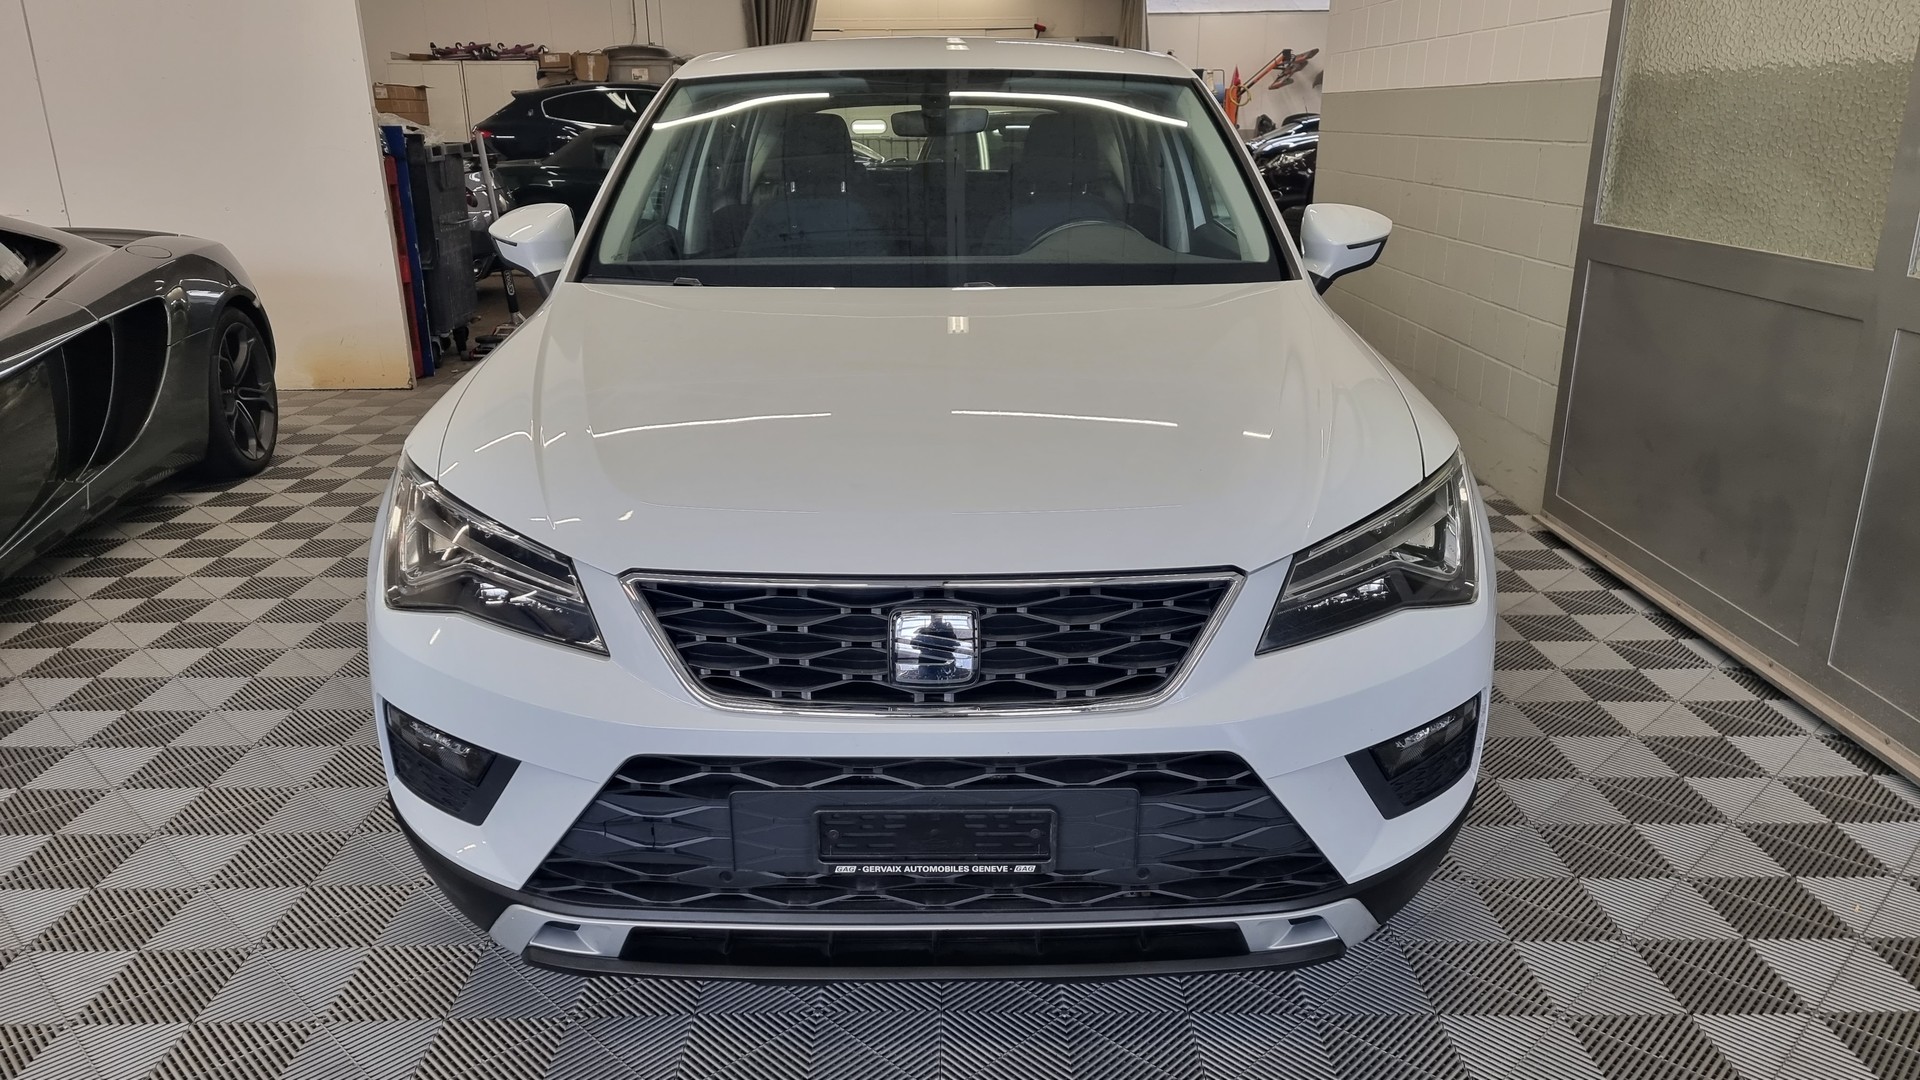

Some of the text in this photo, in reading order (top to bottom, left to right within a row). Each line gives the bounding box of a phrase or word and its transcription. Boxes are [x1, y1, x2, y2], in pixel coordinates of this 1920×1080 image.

[862, 865, 902, 873] GERVAIX
[903, 865, 970, 873] AUTOMOBILES
[971, 865, 1009, 873] GENEVE
